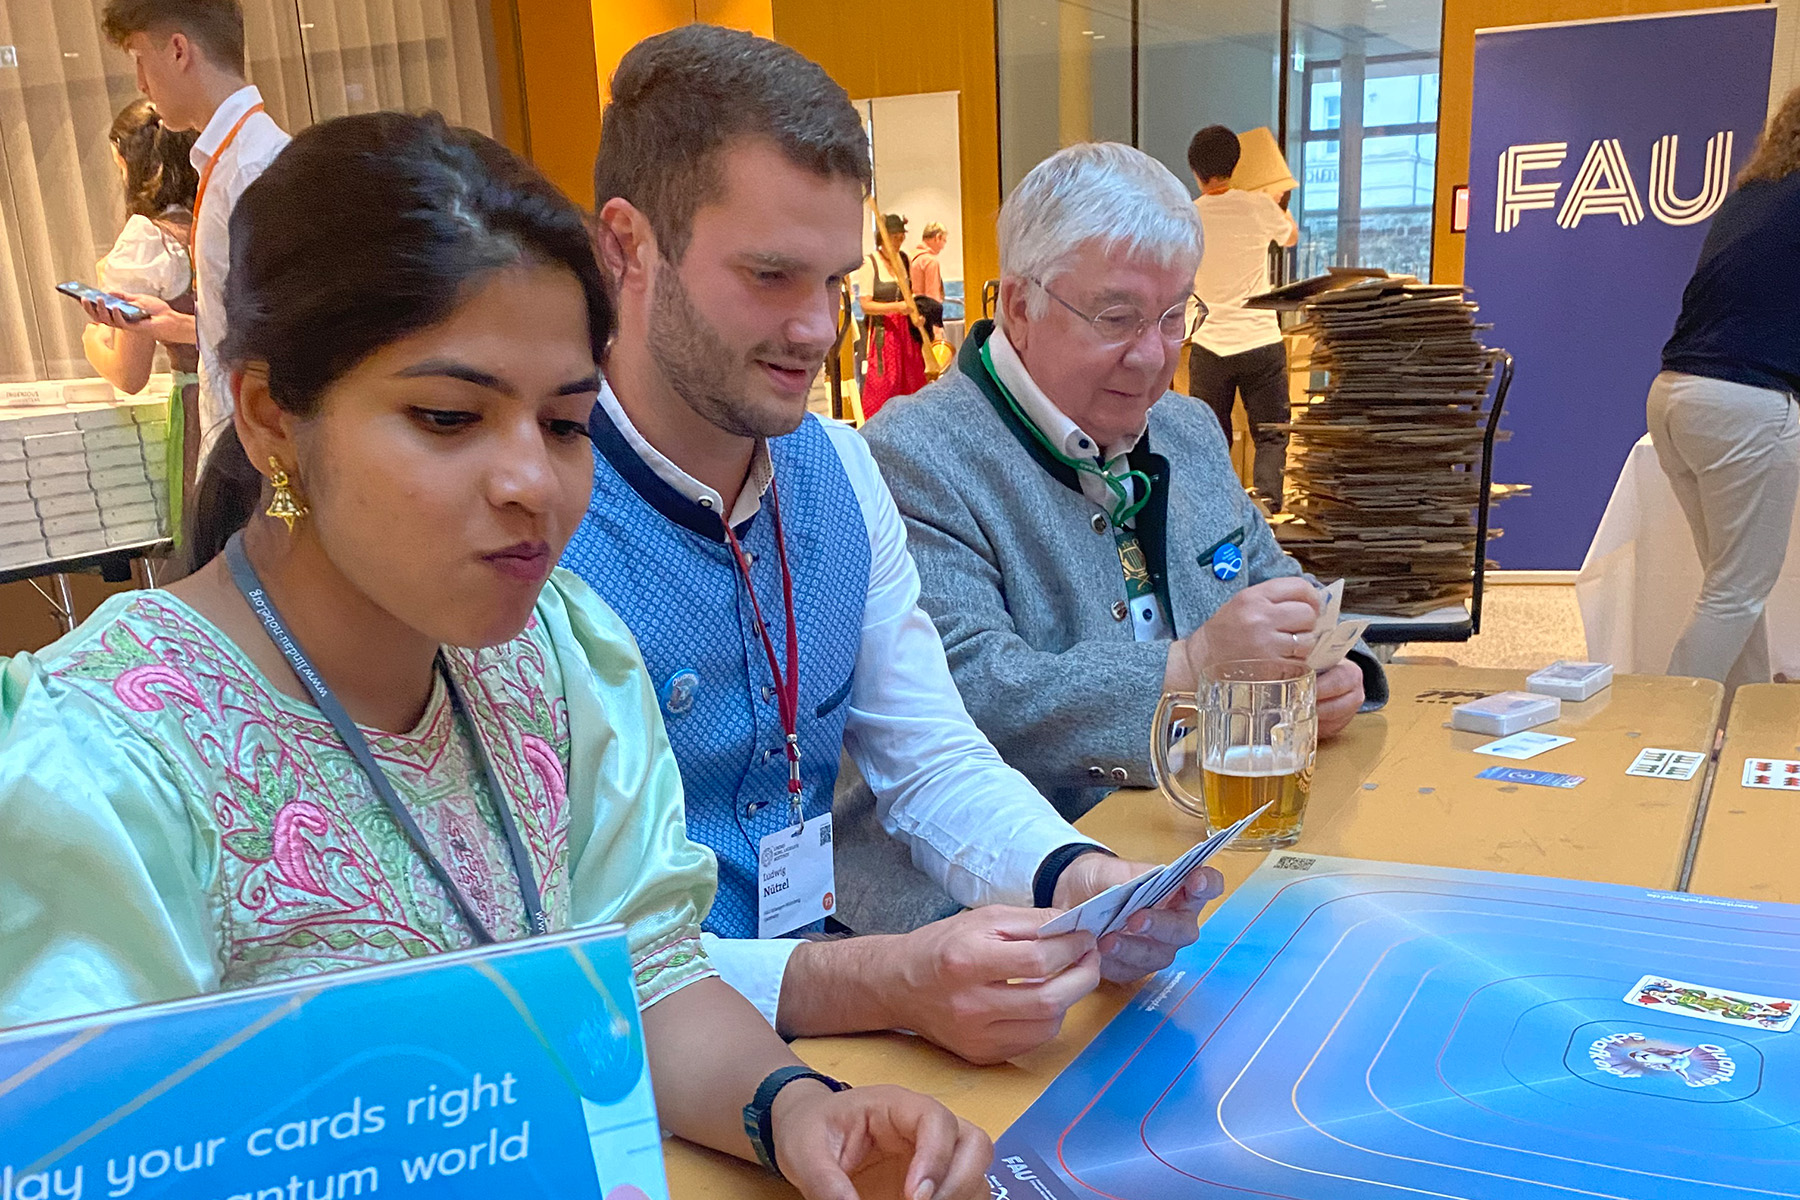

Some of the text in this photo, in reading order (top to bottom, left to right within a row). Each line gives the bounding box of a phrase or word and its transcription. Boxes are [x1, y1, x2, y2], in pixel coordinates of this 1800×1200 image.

[1495, 130, 1733, 233] FAU
[249, 588, 328, 698] www.lindau-nobel.org
[763, 866, 786, 882] Ludwig
[763, 879, 790, 898] Nützel
[1686, 1043, 1736, 1088] Quanten
[0, 1072, 517, 1200] lay your cards right
[401, 1120, 530, 1184] world
[1001, 1155, 1037, 1181] FAU
